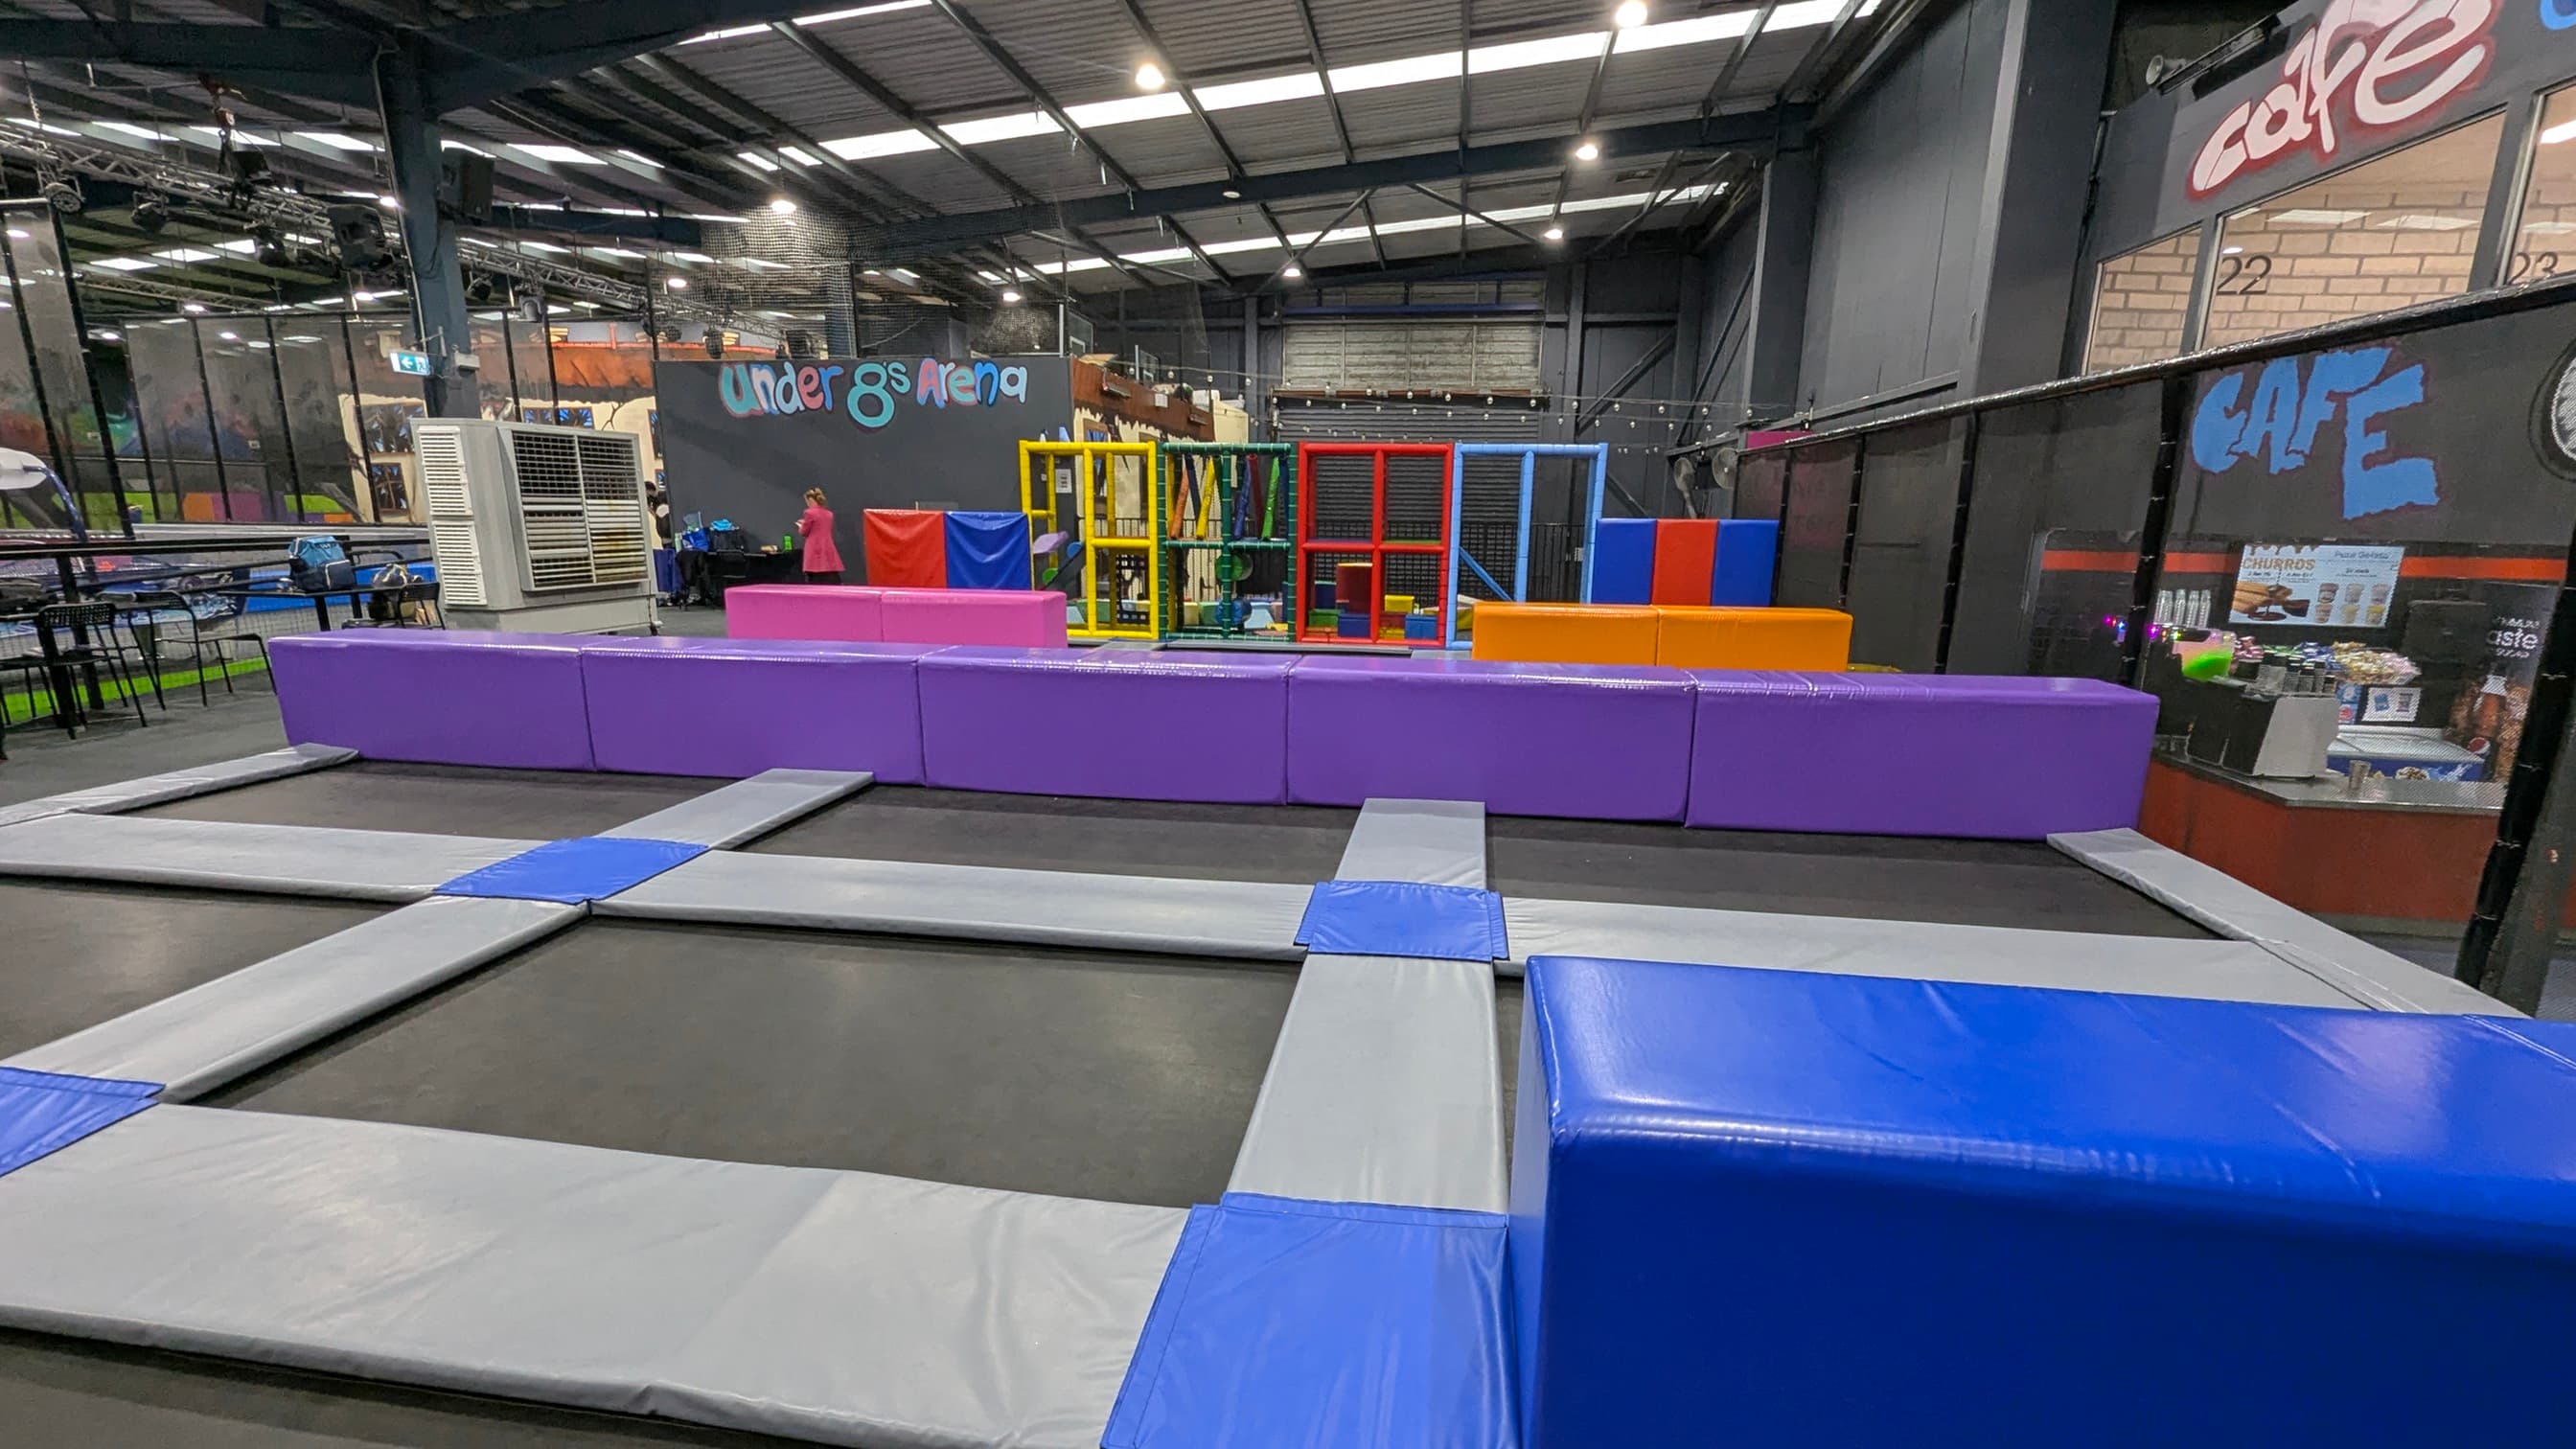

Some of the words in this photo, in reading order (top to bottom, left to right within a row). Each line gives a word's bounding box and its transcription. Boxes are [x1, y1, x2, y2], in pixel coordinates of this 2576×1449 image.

[2216, 253, 2274, 297] 22
[2511, 251, 2560, 287] 23
[719, 358, 843, 419] Under
[916, 356, 1028, 409] Arena
[2191, 347, 2441, 521] CAFE
[2242, 557, 2316, 571] CHURROS
